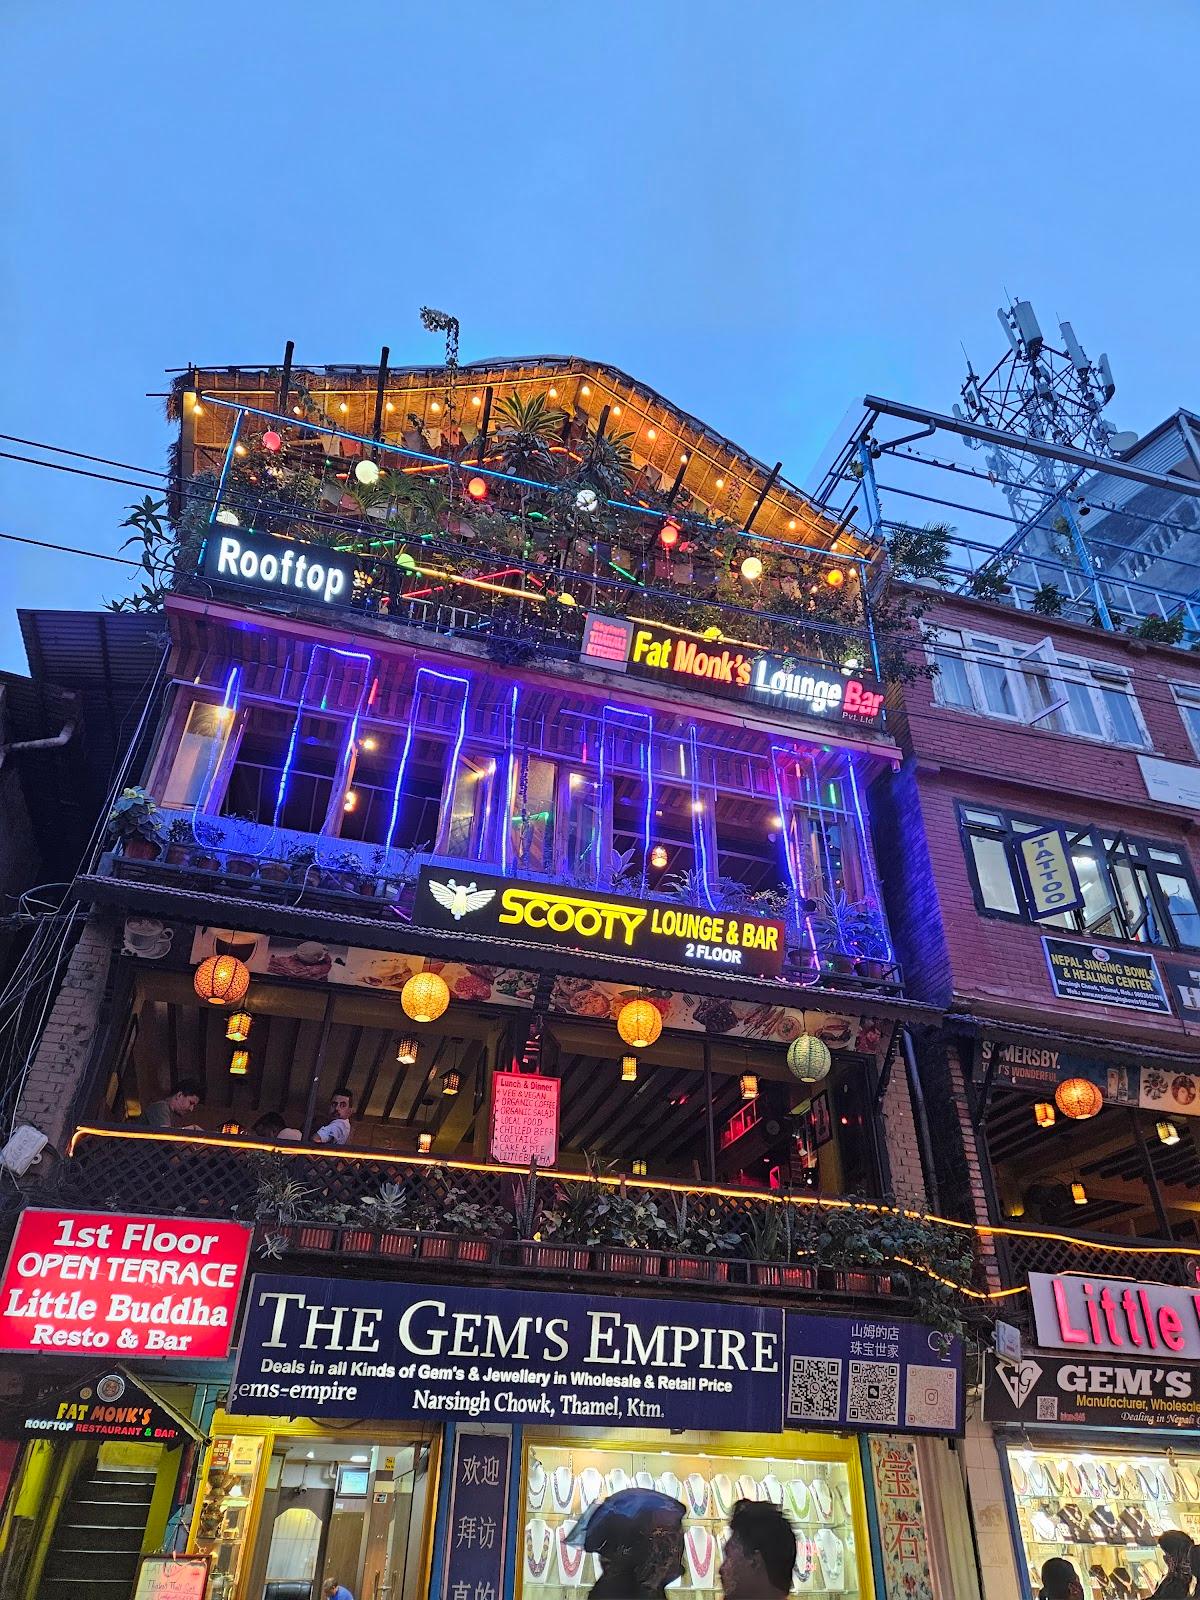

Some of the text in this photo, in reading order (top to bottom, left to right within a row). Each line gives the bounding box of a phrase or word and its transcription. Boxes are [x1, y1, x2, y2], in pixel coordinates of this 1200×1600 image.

[217, 537, 344, 601] Rooftop
[633, 631, 884, 716] Fat Monk's Lounge Bar
[1031, 837, 1066, 904] TATTOO
[499, 888, 778, 951] SCOOTY LOUNGE & BAR
[685, 944, 742, 964] 2 FLOOR
[1051, 954, 1156, 980] NEPAL SINGING BOWLS
[1063, 967, 1154, 991] & HEALING CENTER
[501, 1079, 552, 1092] Lunch & Dinner
[502, 1089, 517, 1098] VEG
[523, 1091, 546, 1100] VEGAN
[501, 1098, 555, 1109] ORGANIC COFFEE
[501, 1107, 554, 1118] ORGANIC SALAD
[500, 1126, 554, 1136] CHILLED BEER
[501, 1116, 542, 1126] LOCAL FOOD
[500, 1144, 519, 1152] CAKE
[53, 1220, 218, 1255] 1st Floor
[17, 1253, 237, 1288] OPEN TERRACE
[4, 1289, 228, 1327] Little Buddha
[1052, 1279, 1185, 1351] Little
[31, 1325, 191, 1352] Resto & Bar
[259, 1292, 779, 1373] THE GEM'S EMPIRE
[851, 1323, 900, 1341] 山姆的店
[850, 1341, 899, 1359] 珠宝世家
[261, 1358, 733, 1393] Deals in all Kinds of Gem's & Jewellery in Wholesale & Retail Price
[1056, 1365, 1192, 1399] GEM'S
[56, 1402, 152, 1426] FAT MONK'S
[412, 1389, 490, 1416] Narsingh
[494, 1391, 555, 1418] Chowk,
[560, 1394, 623, 1419] Thamel,
[626, 1397, 665, 1419] Ktm.
[1076, 1394, 1148, 1411] Manufacturer,
[24, 1419, 175, 1438] ROOFTOP RESTAURANT & BAR
[1120, 1411, 1154, 1425] Dealing
[1157, 1413, 1165, 1423] in
[1166, 1414, 1195, 1427] Nepali
[461, 1454, 500, 1486] 欢迎
[456, 1515, 497, 1550] 拜访
